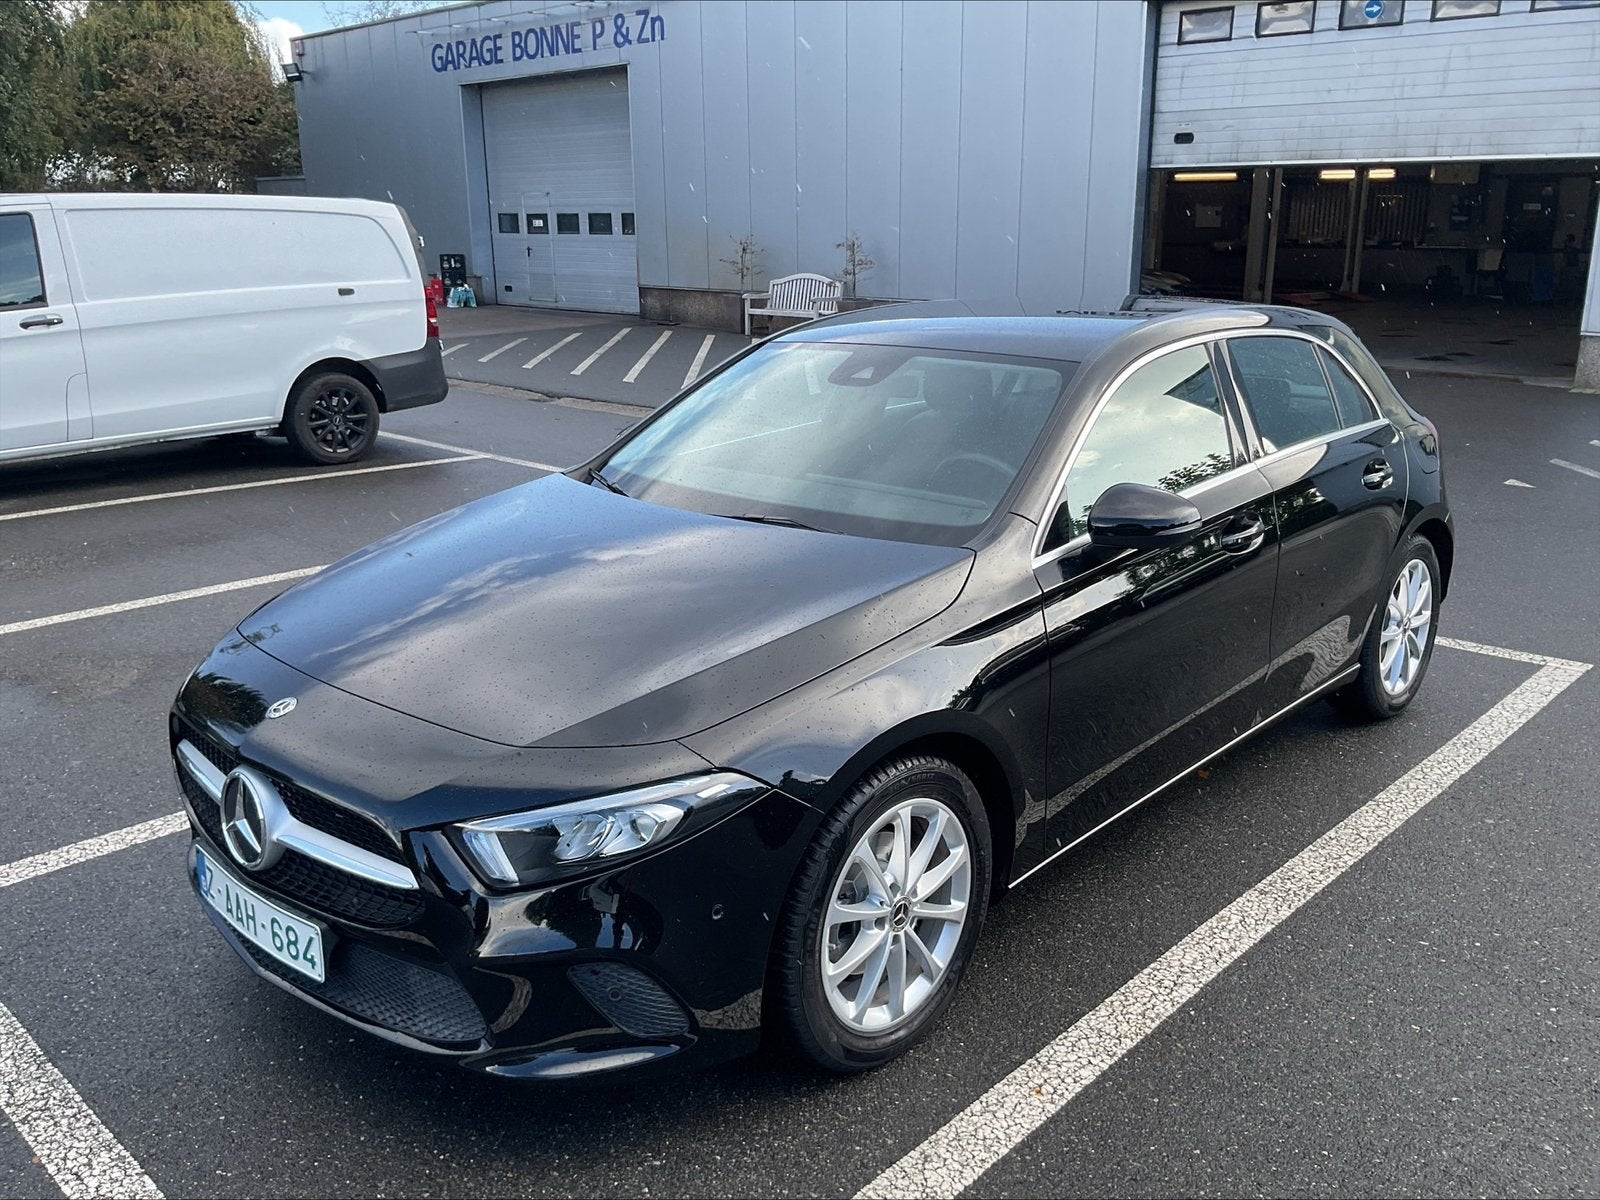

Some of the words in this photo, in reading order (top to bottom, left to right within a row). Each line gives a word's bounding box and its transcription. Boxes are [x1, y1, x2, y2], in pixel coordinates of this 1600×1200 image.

[431, 34, 504, 73] GARAGE
[511, 21, 582, 62] BONNE
[592, 18, 605, 50] P
[613, 13, 632, 49] &
[635, 9, 665, 44] Zn
[206, 865, 317, 970] Z-AAH-684
